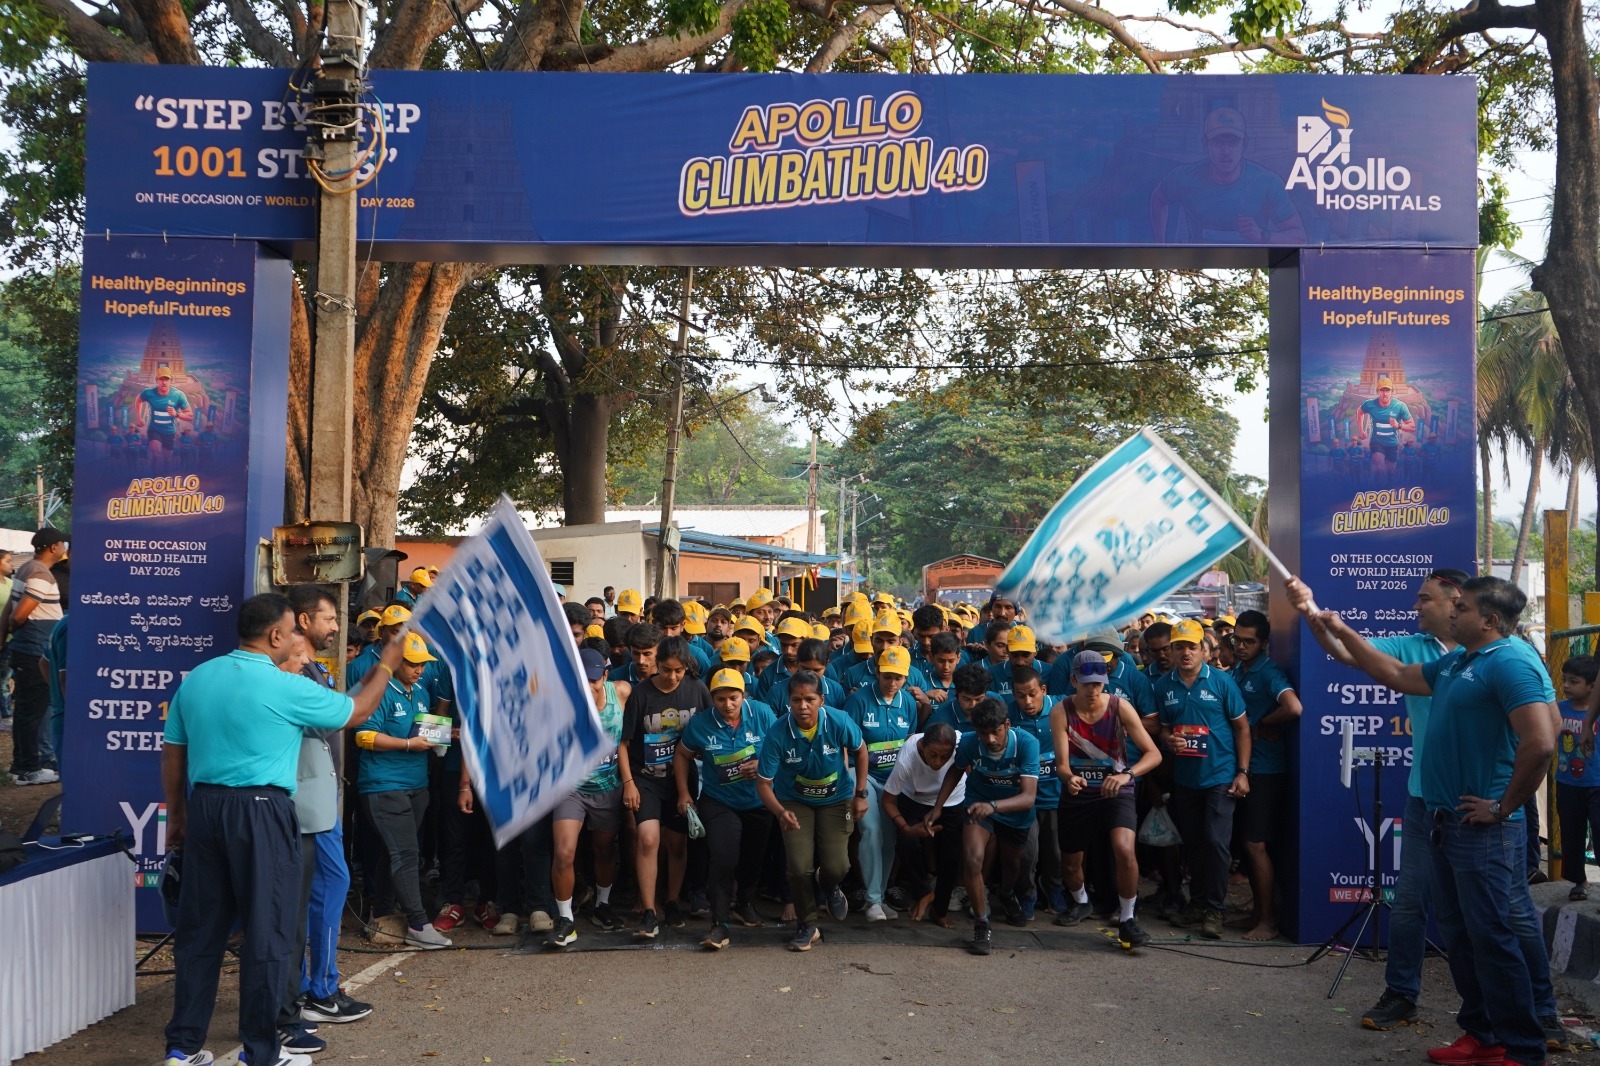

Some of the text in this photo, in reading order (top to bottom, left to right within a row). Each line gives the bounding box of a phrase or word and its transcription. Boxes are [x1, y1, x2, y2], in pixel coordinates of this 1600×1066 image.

[135, 95, 252, 130] “STEP
[730, 91, 923, 151] APOLLO
[153, 146, 246, 177] 1001
[680, 138, 932, 214] CLIMBATHON
[934, 146, 987, 191] 4.0
[1285, 157, 1411, 205] Apollo
[135, 192, 153, 204] ON
[156, 193, 179, 205] THE
[182, 194, 243, 206] OCCASION
[246, 195, 262, 206] OF
[265, 195, 307, 207] WORLD
[360, 197, 383, 208] DAY
[386, 197, 415, 208] 2026
[1326, 194, 1441, 211] HOSPITALS
[91, 275, 246, 296] HealthyBeginnings
[1308, 286, 1465, 304] HealthyBeginnings
[105, 300, 231, 317] HopefulFutures
[1323, 311, 1450, 328] HopefulFutures
[127, 475, 200, 496] APOLLO
[108, 493, 224, 520] CLIMBATHON 4.0
[1351, 487, 1425, 509] APOLLO
[1332, 506, 1449, 534] CLIMBATHON 4.0
[105, 539, 207, 551] ON THE OCCASION
[104, 552, 207, 564] OF WORLD HEALTH
[1331, 554, 1433, 564] ON THE OCCASION
[130, 566, 180, 576] DAY 2026
[1330, 567, 1345, 577] OF
[1347, 568, 1387, 577] WORLD
[1356, 580, 1407, 590] DAY 2026
[97, 667, 173, 690] “STEP
[88, 699, 152, 720] STEP
[106, 730, 165, 751] STEP
[418, 727, 441, 738] 2050
[877, 753, 897, 764] 2502
[1334, 890, 1351, 900] WE
